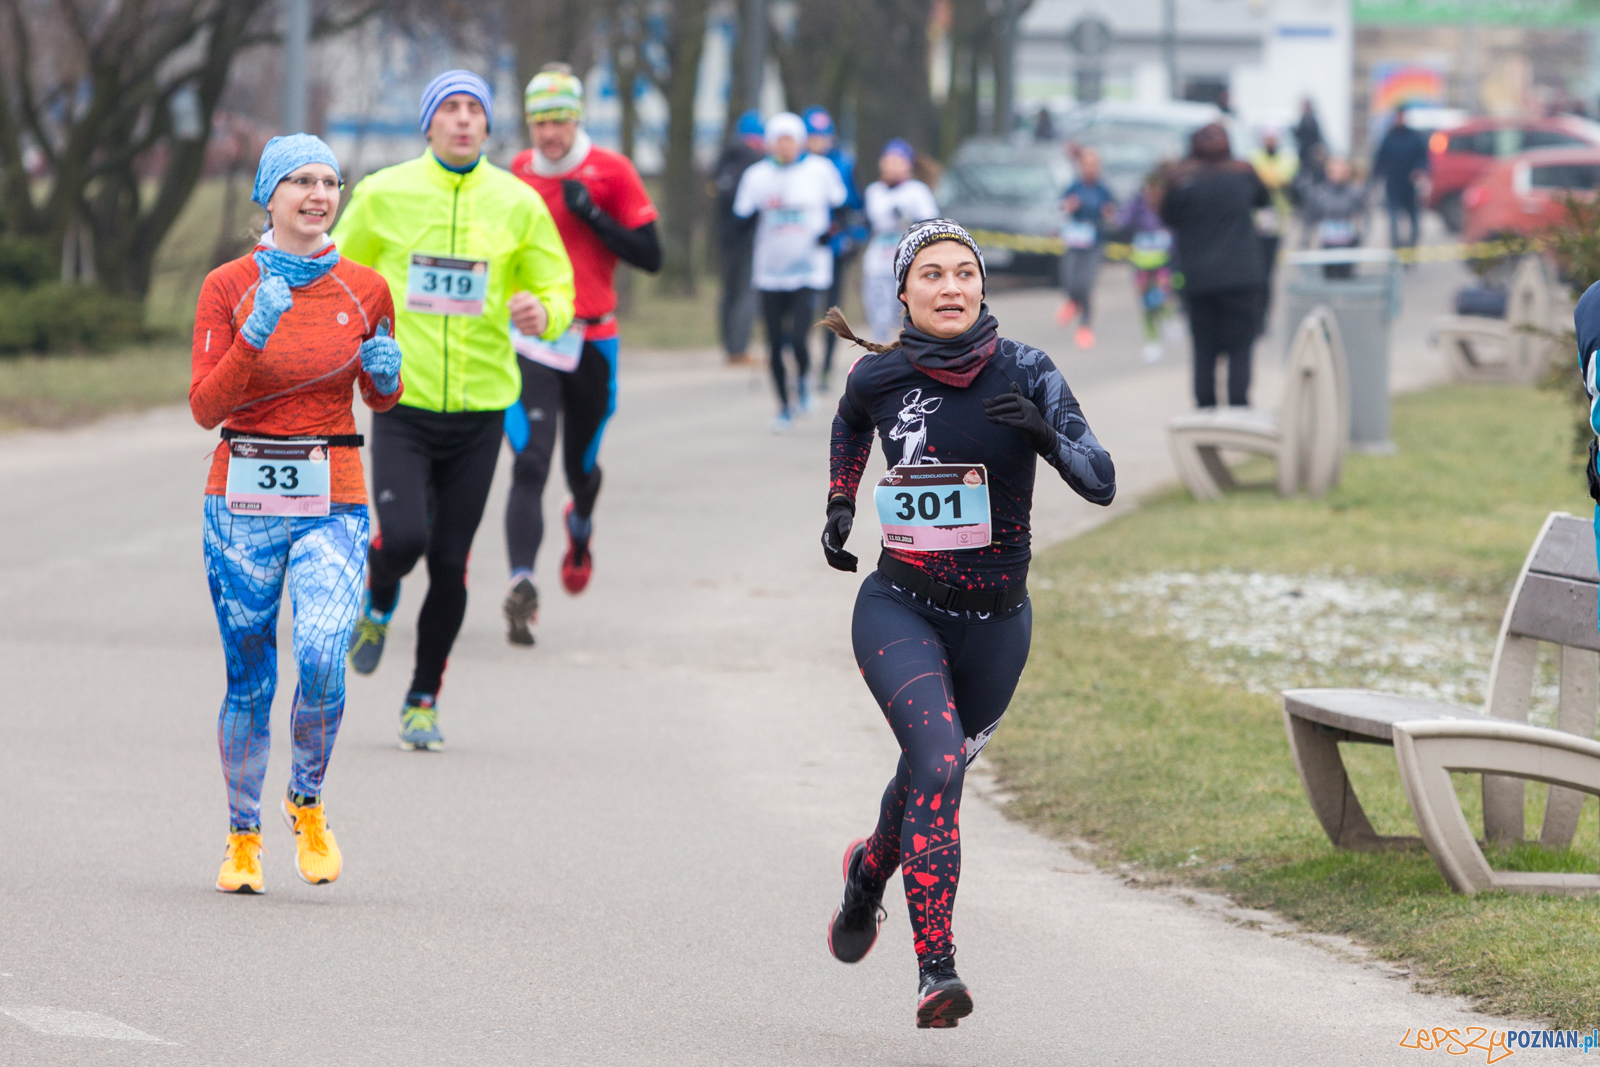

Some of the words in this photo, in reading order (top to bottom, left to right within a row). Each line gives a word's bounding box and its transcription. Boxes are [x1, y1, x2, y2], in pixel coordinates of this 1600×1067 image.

[422, 272, 472, 295] 319
[257, 465, 299, 490] 33
[894, 490, 962, 521] 301
